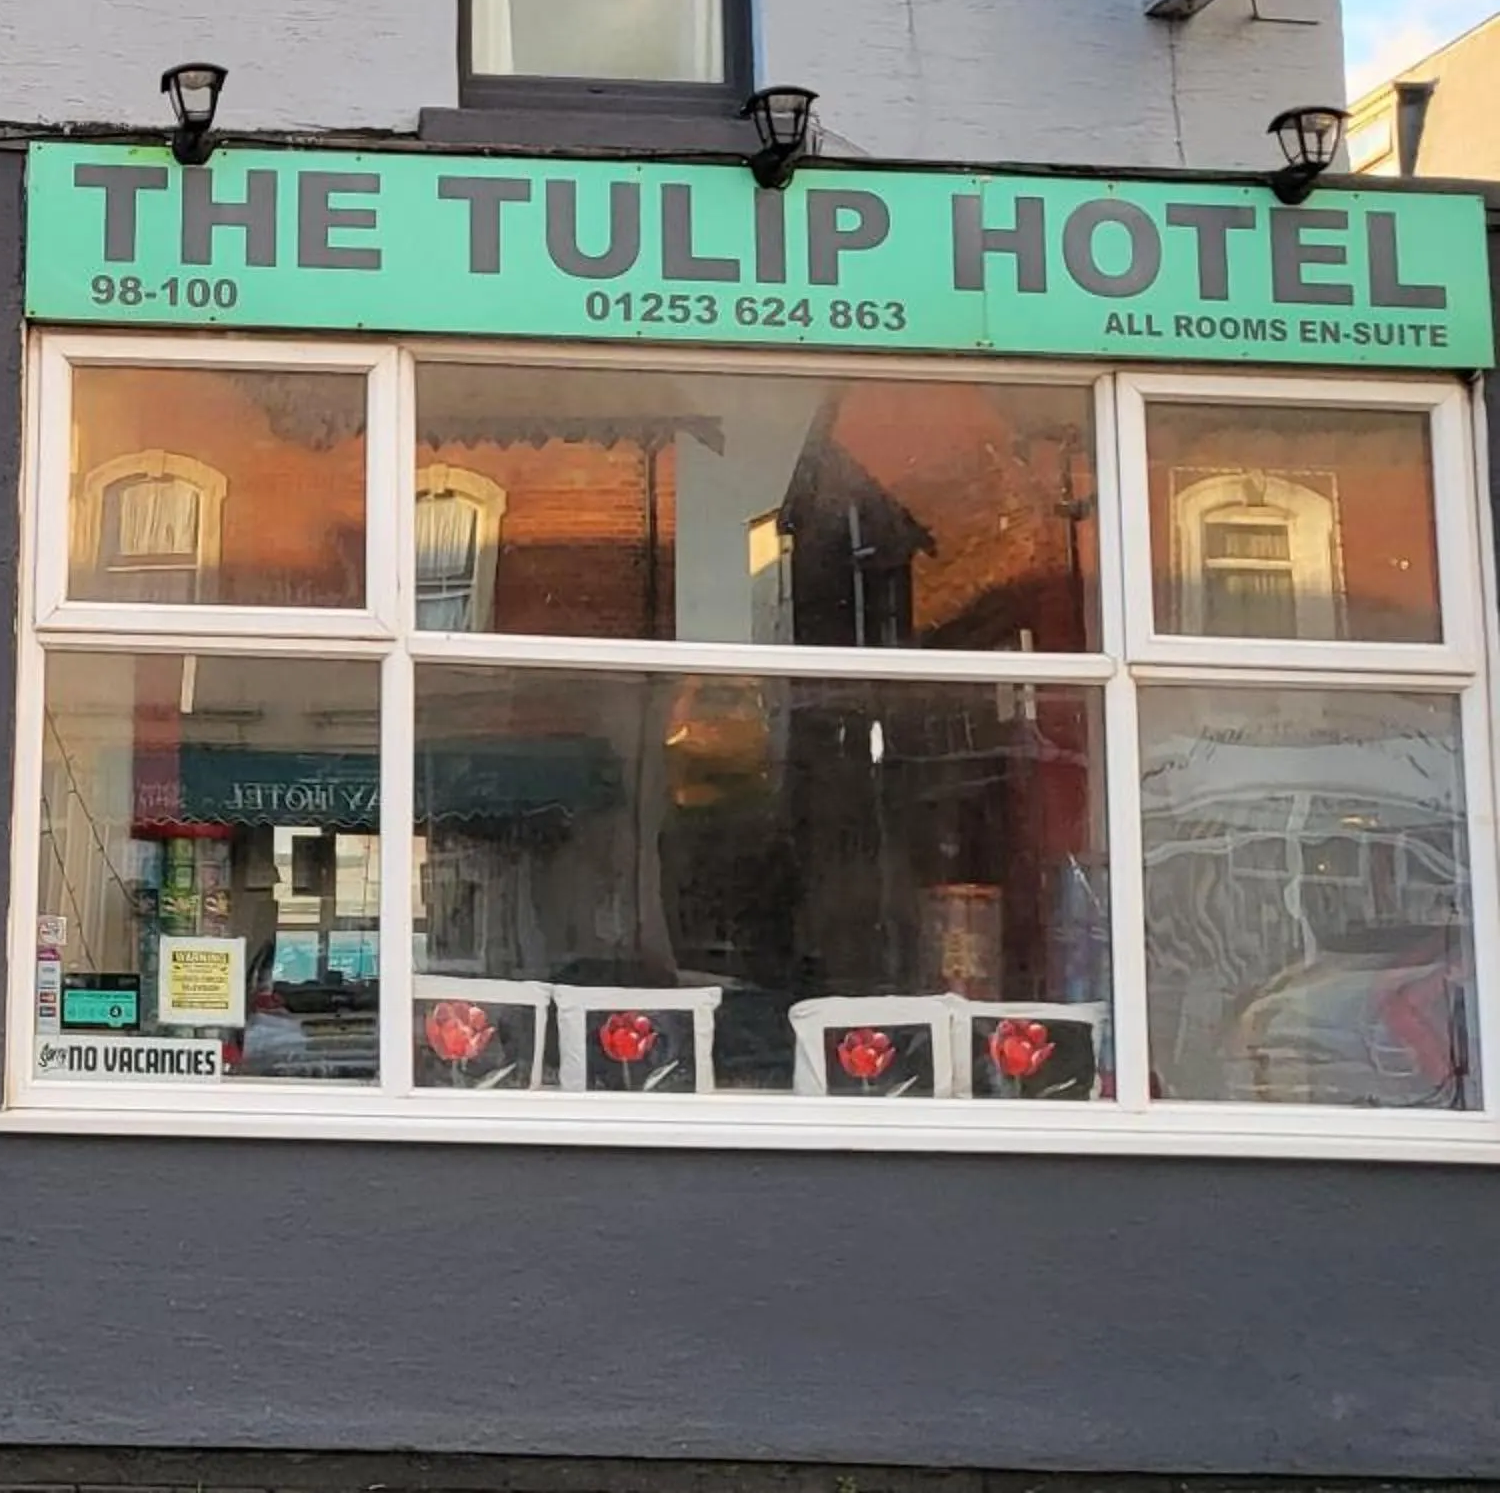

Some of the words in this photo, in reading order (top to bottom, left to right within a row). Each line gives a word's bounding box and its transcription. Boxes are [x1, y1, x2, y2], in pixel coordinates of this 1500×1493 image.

[73, 162, 382, 270] THE
[437, 174, 892, 287] TULIP
[951, 194, 1449, 310] HOTEL
[90, 275, 238, 308] 98-100
[585, 290, 719, 325] 01253
[734, 296, 815, 329] 624
[828, 300, 908, 332] 863
[1104, 313, 1164, 338] ALL
[1173, 314, 1289, 344] ROOMS
[1299, 318, 1450, 349] EN-SUITE
[69, 1045, 97, 1072] NO
[102, 1045, 217, 1077] VACANCIES
